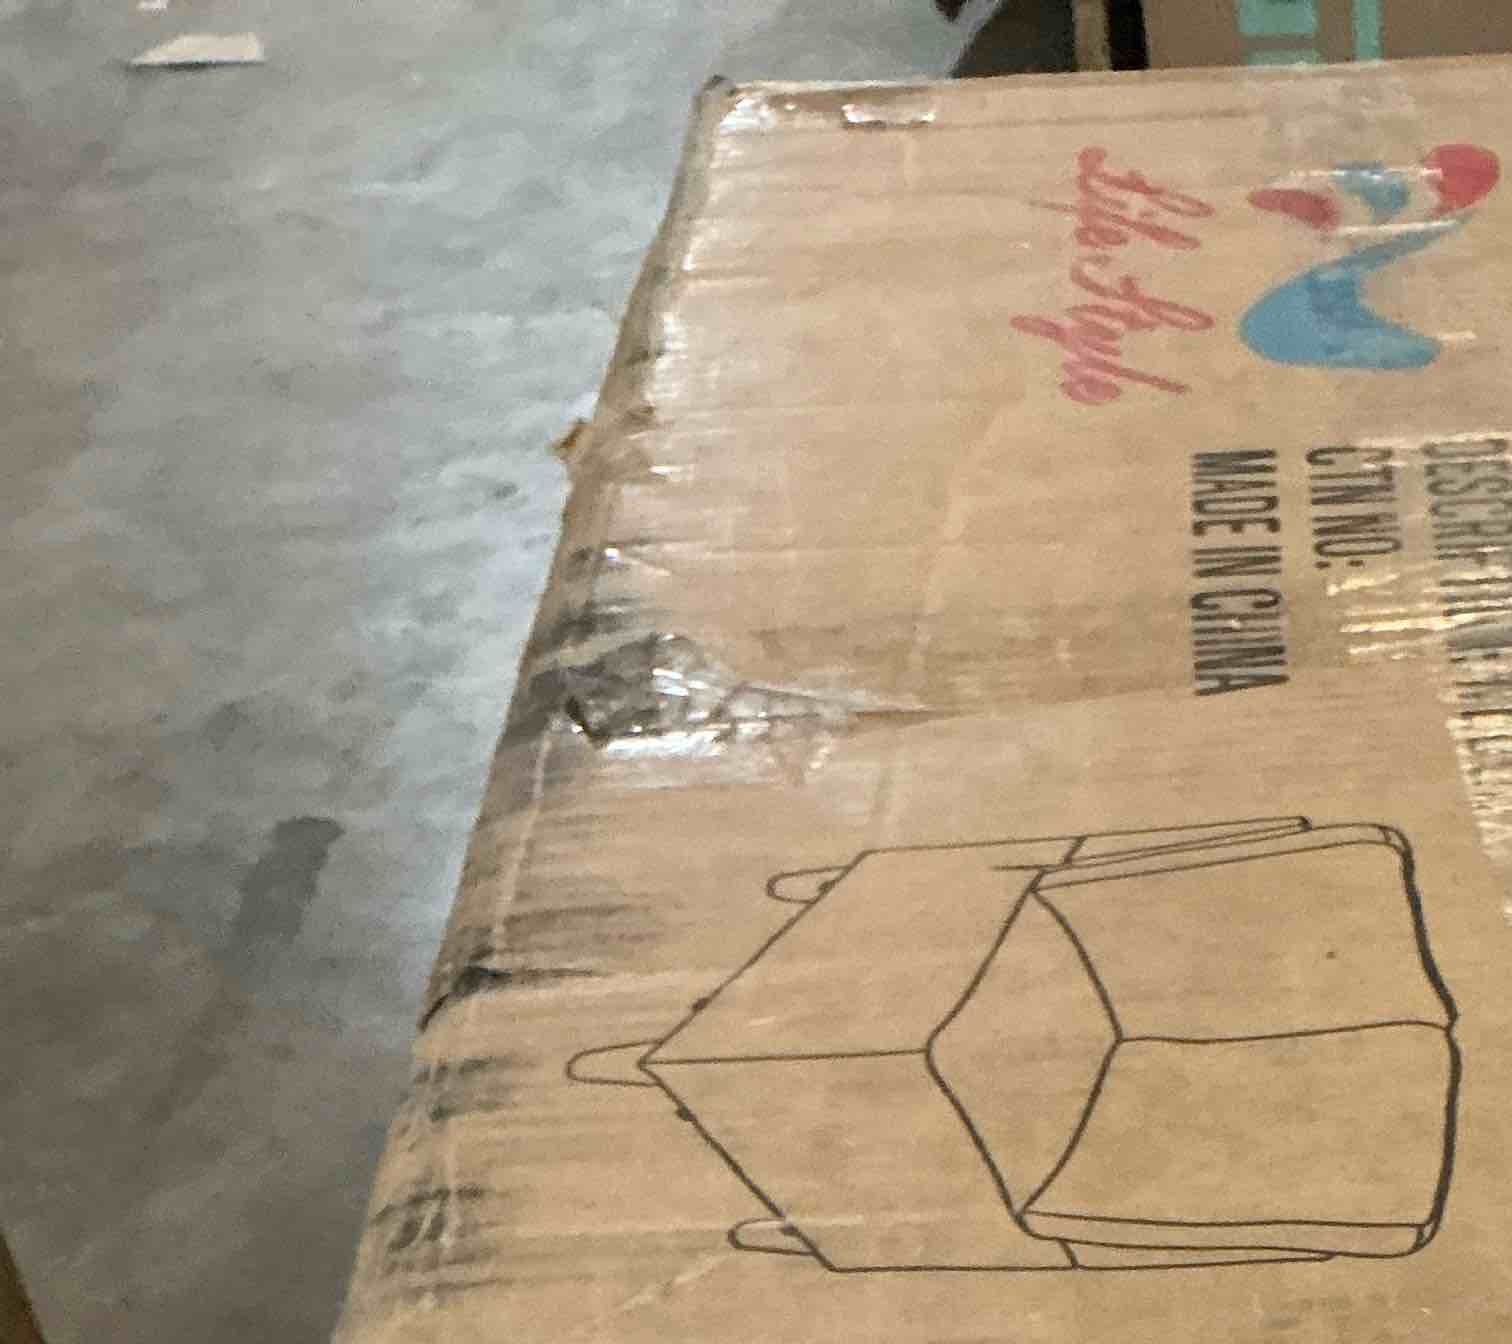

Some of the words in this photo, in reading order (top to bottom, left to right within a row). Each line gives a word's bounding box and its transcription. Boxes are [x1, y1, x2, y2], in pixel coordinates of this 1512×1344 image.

[1190, 449, 1280, 536] MADE
[1305, 446, 1400, 506] CTN
[1193, 543, 1283, 579] IN
[1313, 512, 1405, 571] NO:
[1192, 588, 1291, 698] CHINA
